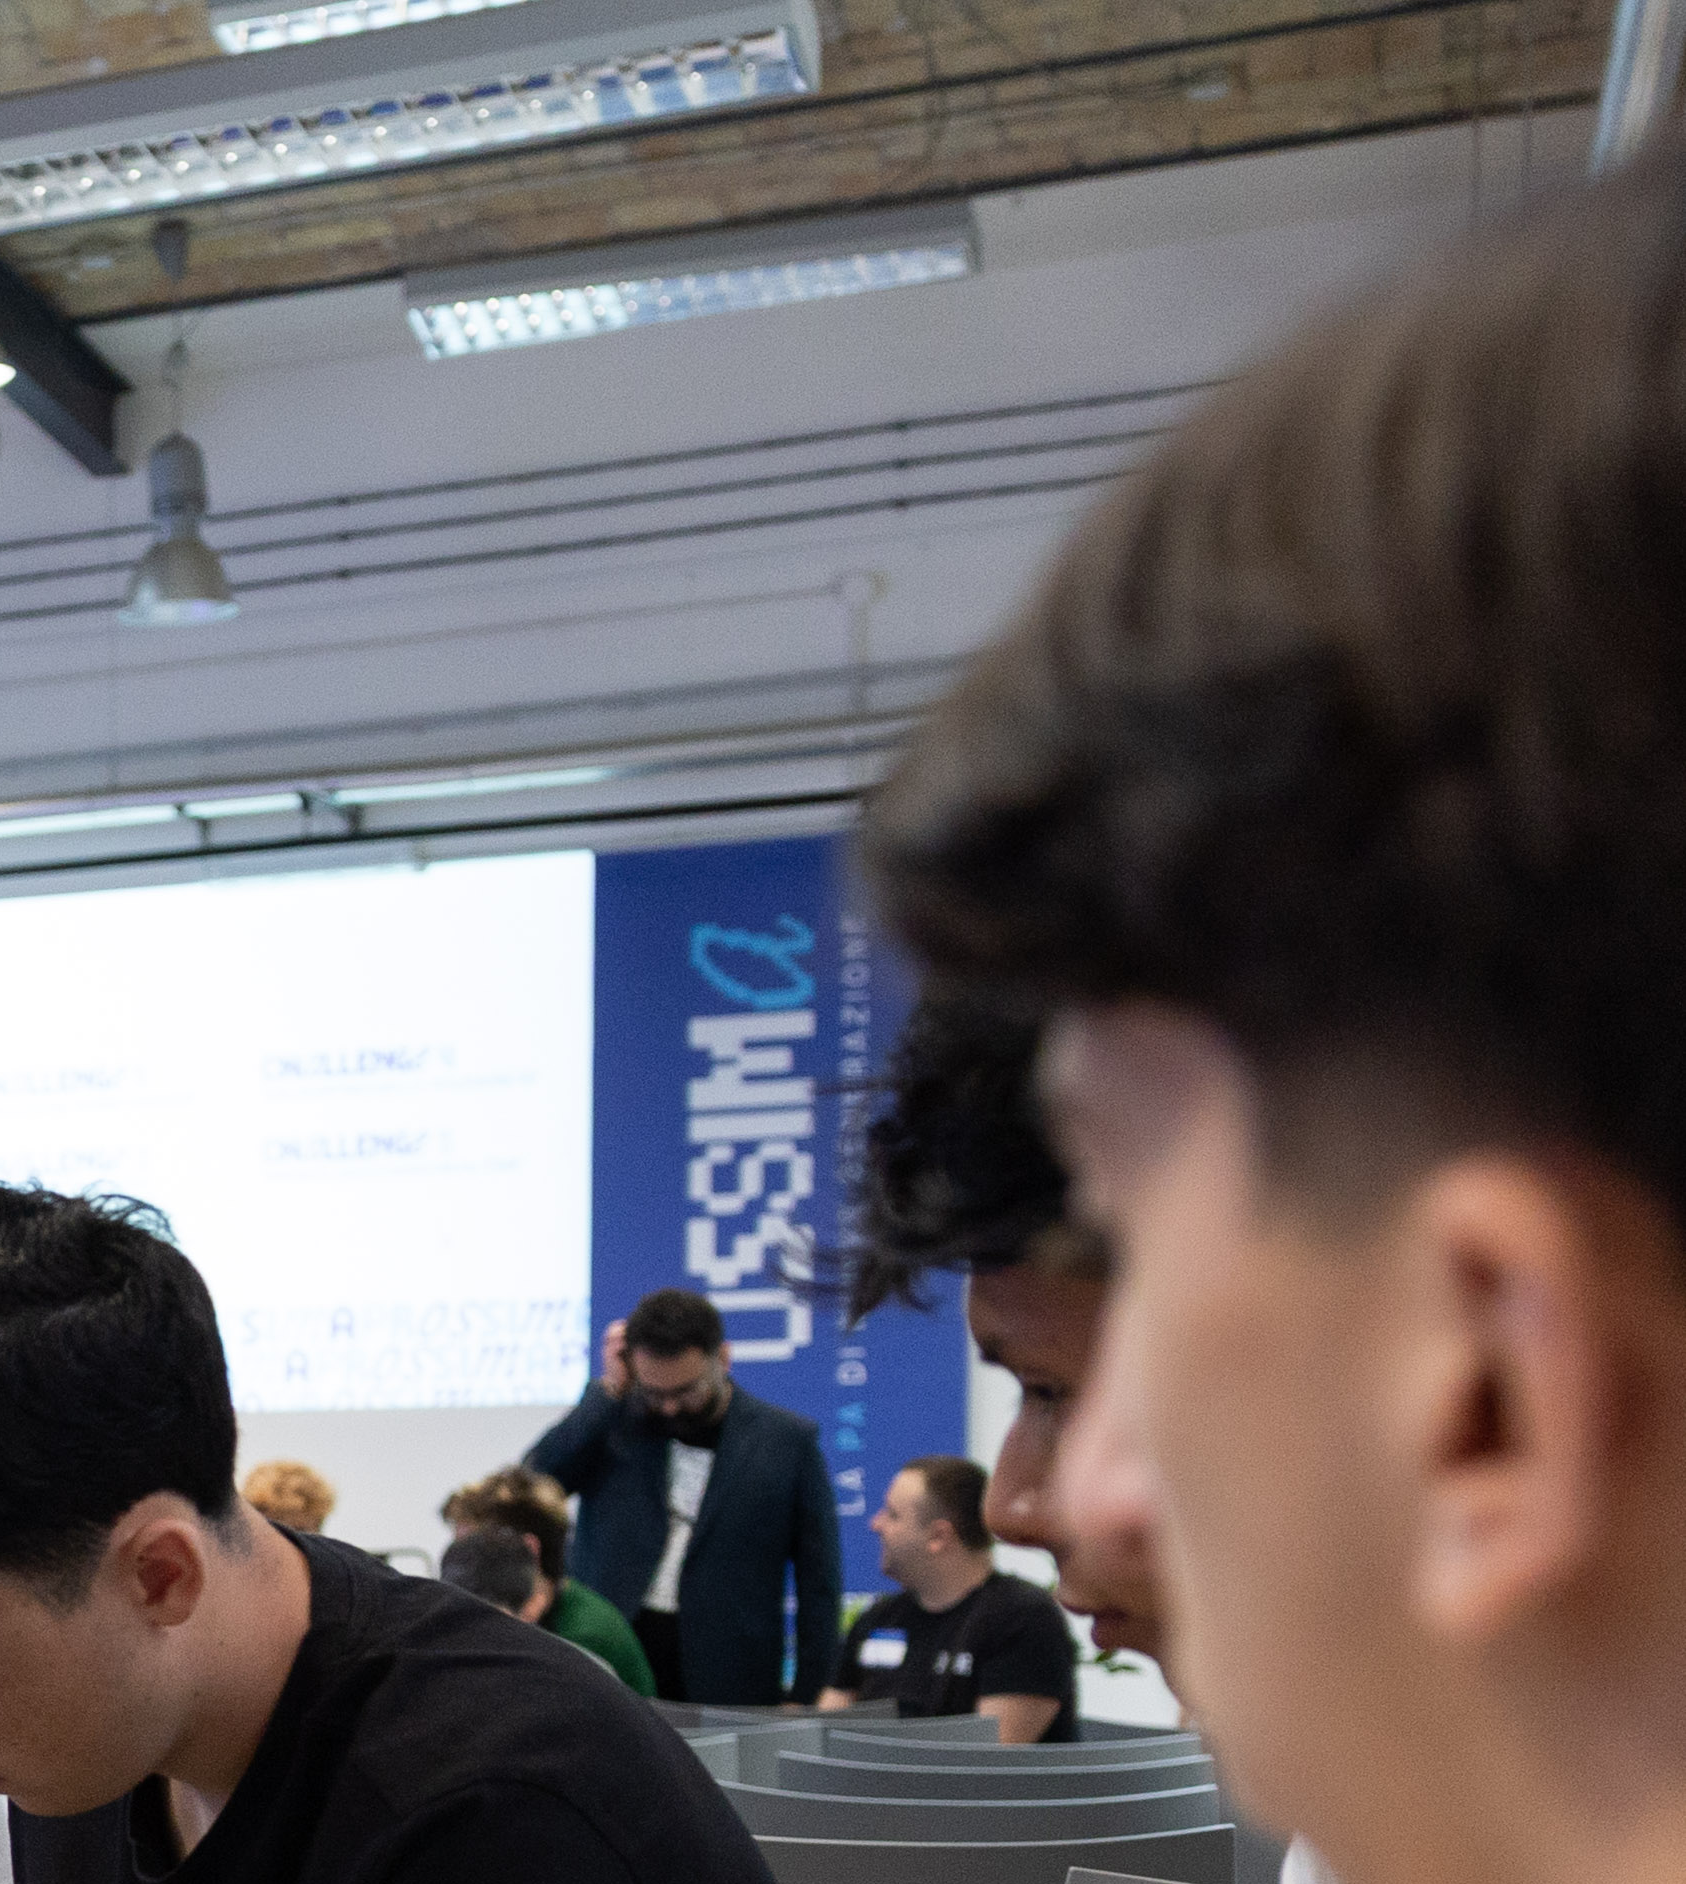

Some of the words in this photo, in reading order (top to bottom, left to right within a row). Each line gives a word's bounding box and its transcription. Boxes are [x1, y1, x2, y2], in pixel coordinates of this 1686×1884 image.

[836, 1346, 868, 1386] DI
[835, 1402, 868, 1451] PA
[835, 1466, 867, 1517] LA
